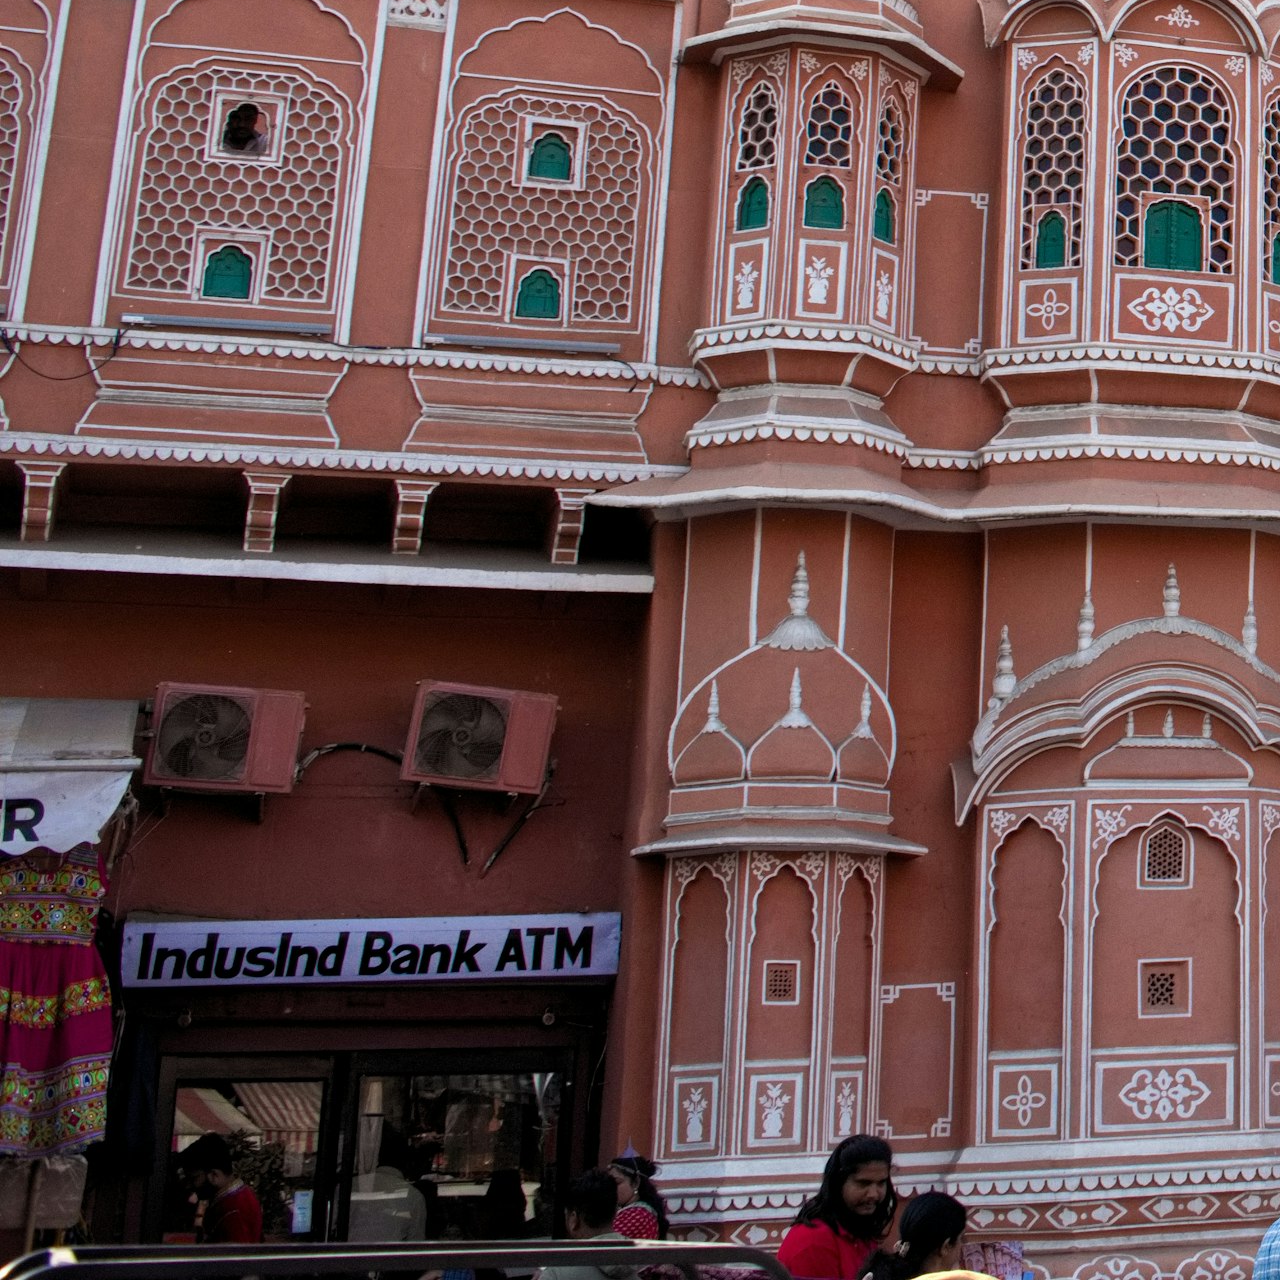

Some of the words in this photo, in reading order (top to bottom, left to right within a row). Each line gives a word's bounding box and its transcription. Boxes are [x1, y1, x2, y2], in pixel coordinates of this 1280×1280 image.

[0, 798, 45, 842] R
[137, 932, 350, 980] IndusInd
[358, 930, 488, 976] Bank
[495, 926, 594, 971] ATM
